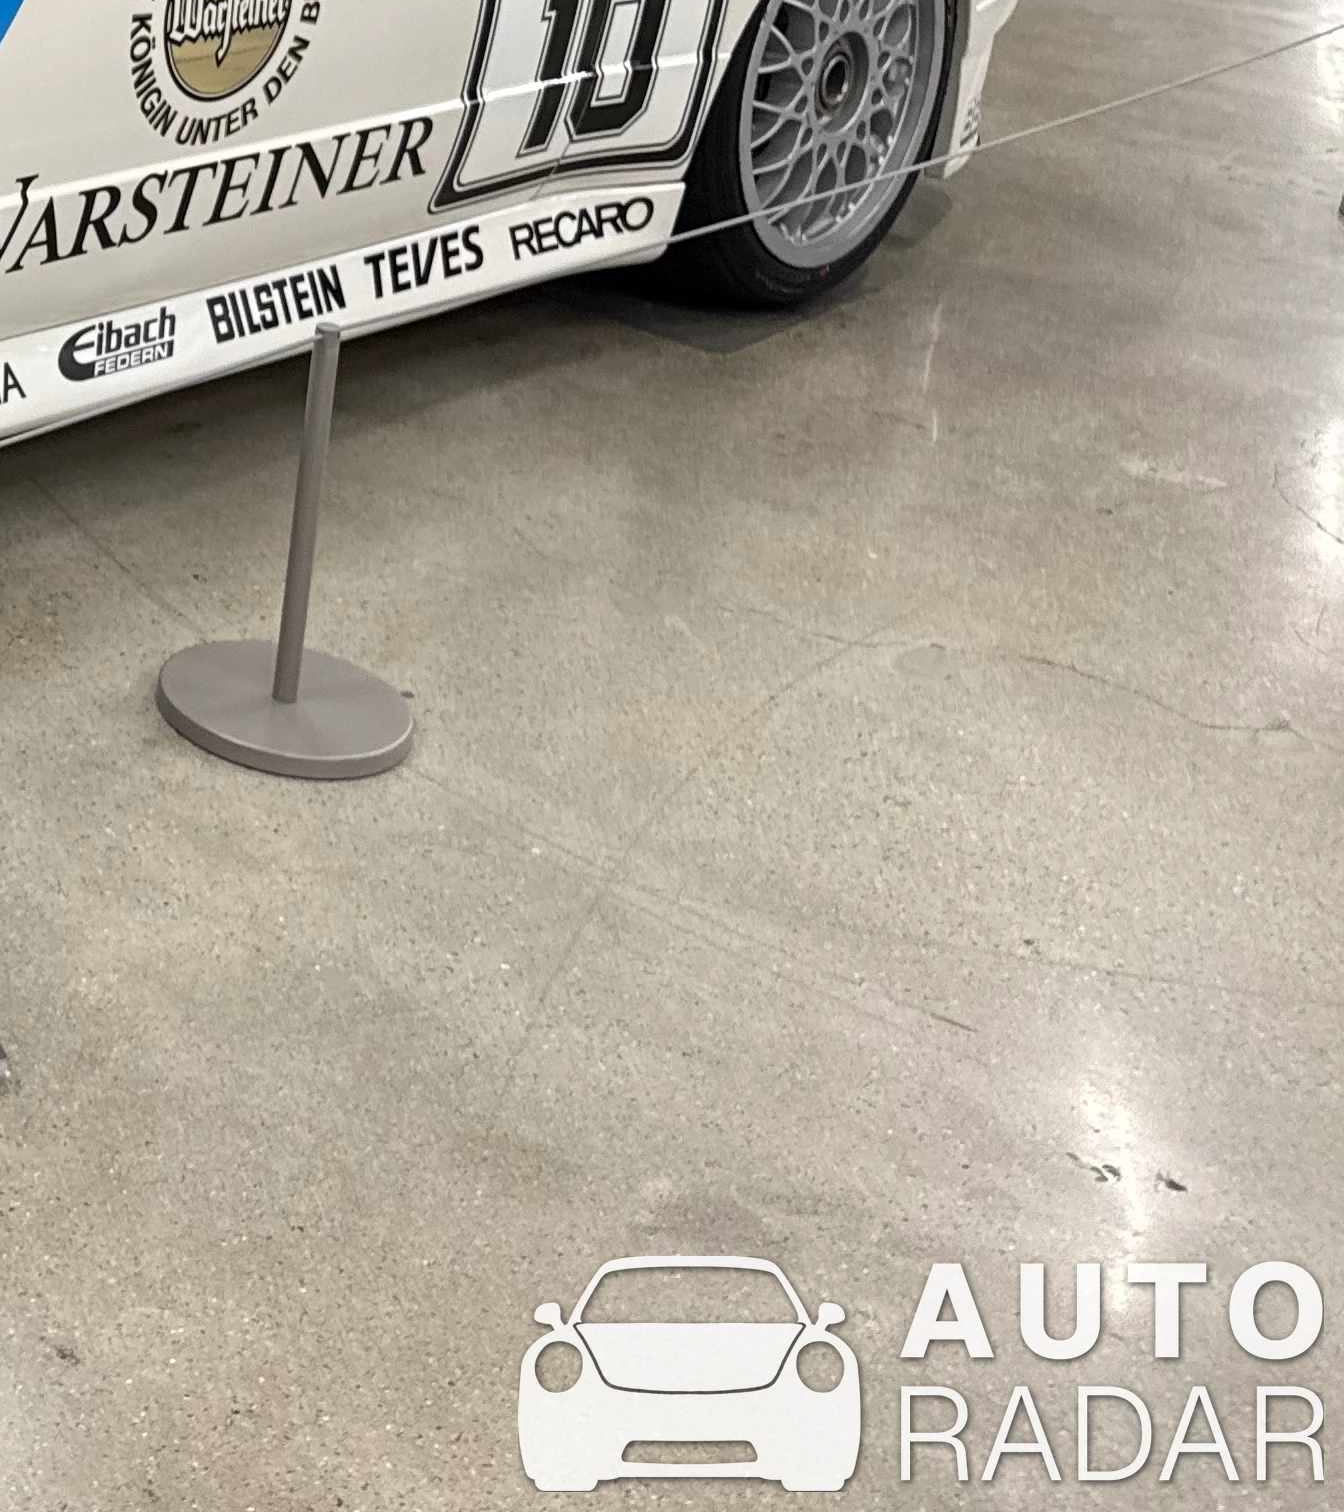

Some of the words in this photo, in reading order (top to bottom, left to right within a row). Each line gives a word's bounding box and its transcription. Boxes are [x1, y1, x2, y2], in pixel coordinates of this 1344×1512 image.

[129, 12, 178, 138] KÖNIGIN
[174, 97, 259, 146] UNTER
[261, 35, 310, 105] DEN
[207, 263, 348, 346] BILSTEIN
[364, 225, 485, 301] TEVES
[509, 196, 655, 261] RECARO
[58, 307, 176, 381] Eibach
[92, 340, 171, 378] FEDERN
